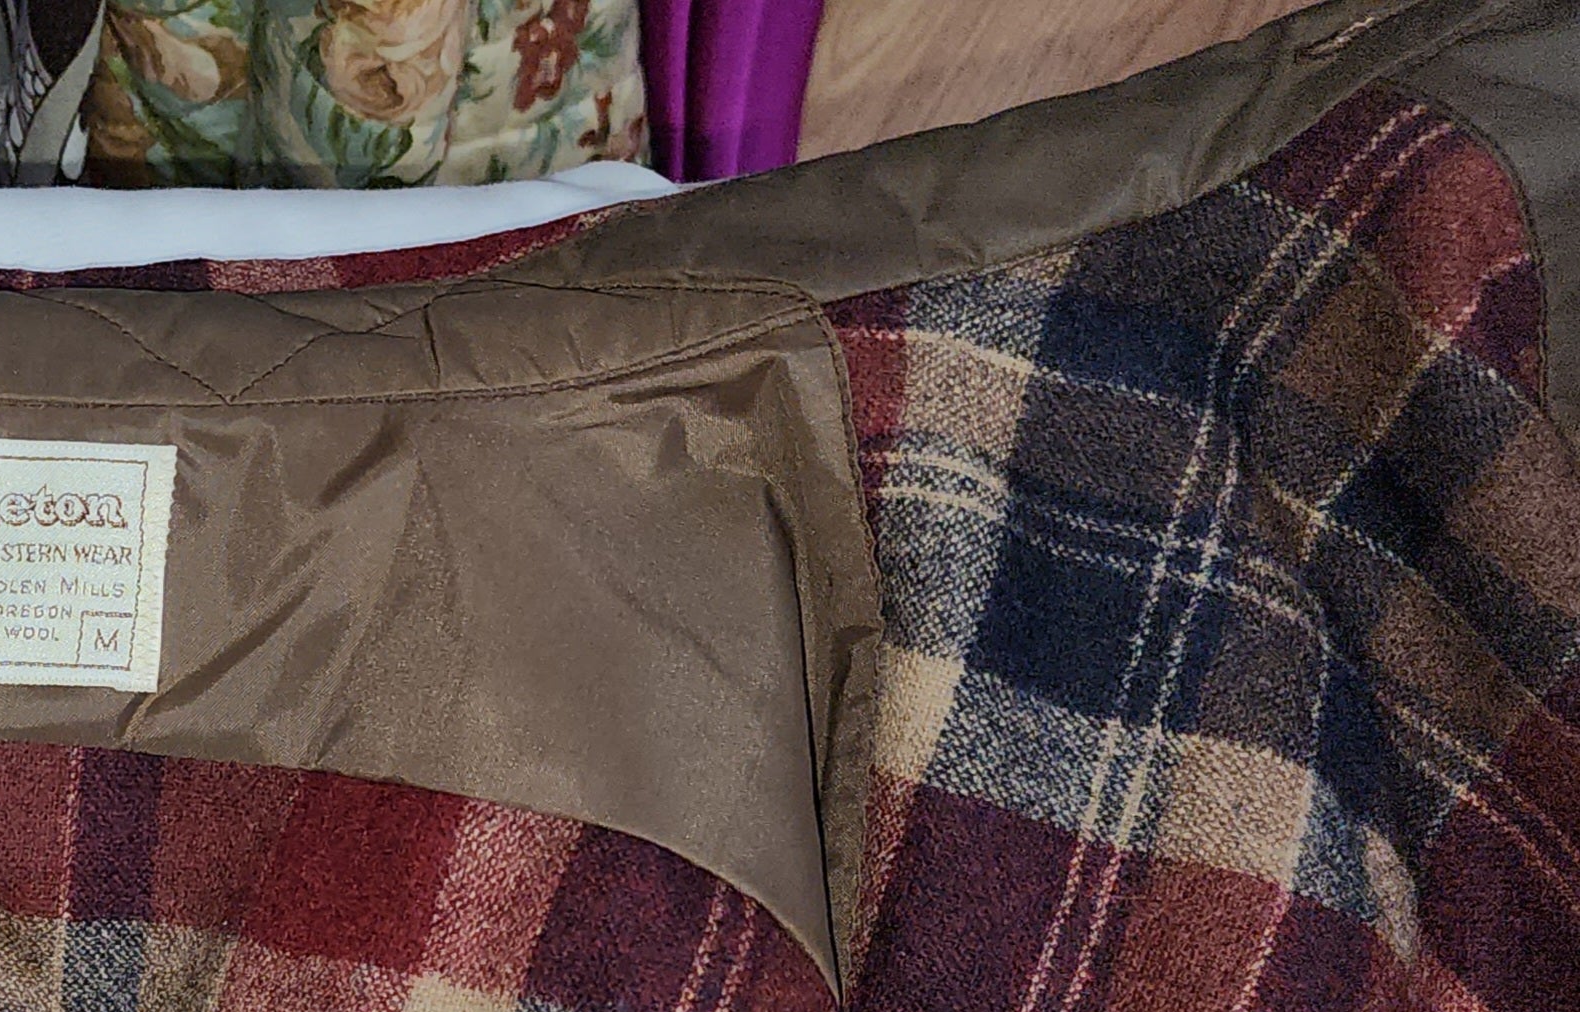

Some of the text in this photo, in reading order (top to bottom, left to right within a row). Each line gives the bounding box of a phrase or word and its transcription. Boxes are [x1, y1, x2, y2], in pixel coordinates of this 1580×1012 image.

[74, 545, 132, 566] WEAR
[3, 627, 60, 642] WOOL
[94, 628, 119, 653] M
